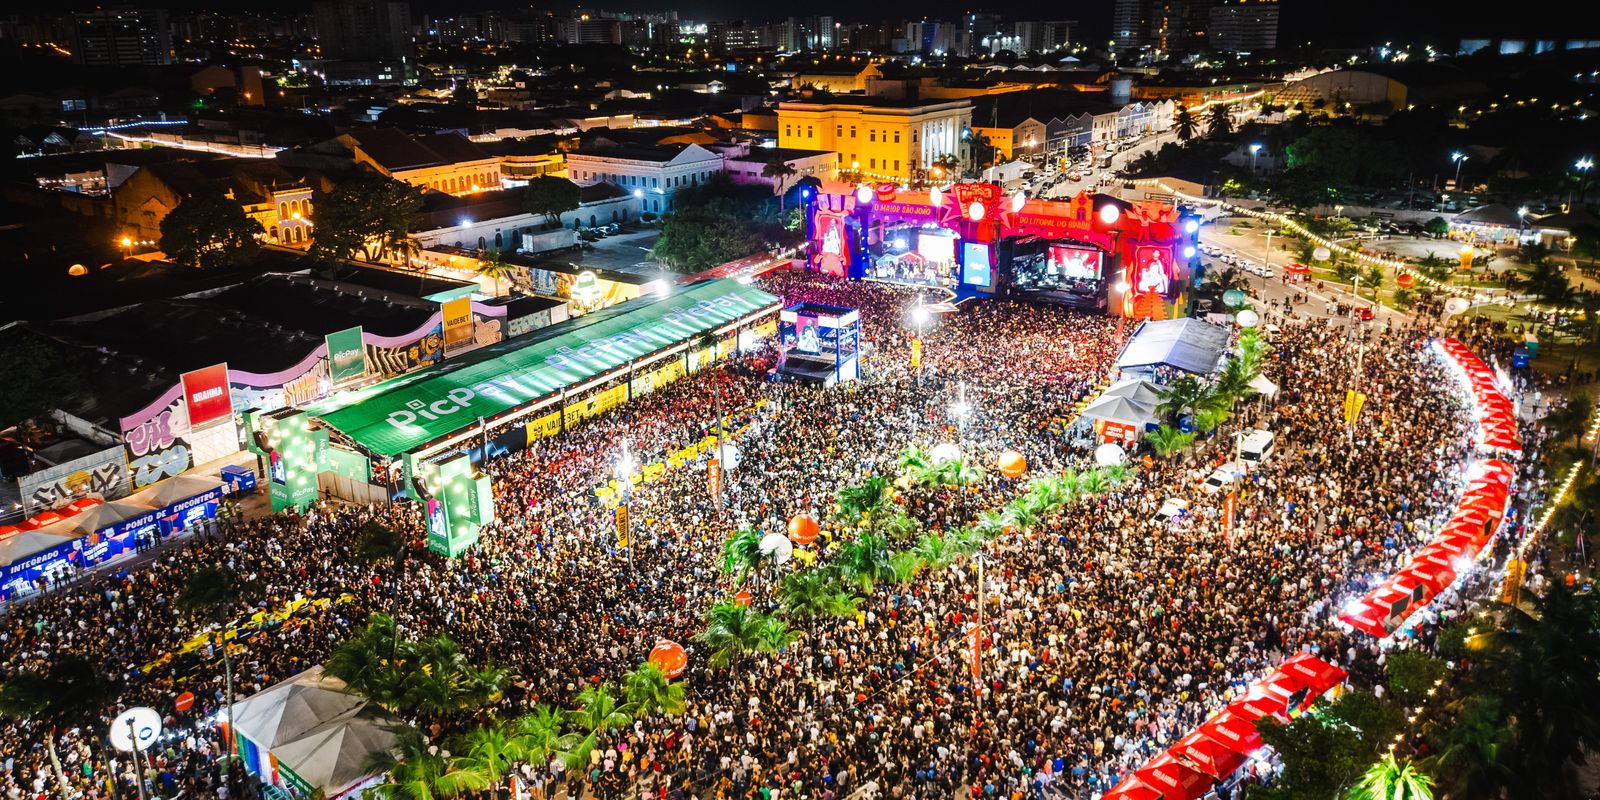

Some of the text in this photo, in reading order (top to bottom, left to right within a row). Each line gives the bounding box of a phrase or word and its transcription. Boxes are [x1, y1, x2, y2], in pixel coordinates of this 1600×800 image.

[446, 314, 470, 327] VAIDEBET
[333, 347, 360, 361] PicPay
[192, 386, 223, 403] BRAHMA
[385, 373, 528, 433] PicPay
[125, 515, 154, 531] PONTO
[156, 509, 167, 520] DE
[173, 491, 215, 513] ENCONTRO
[10, 550, 60, 574] INTEGRADO
